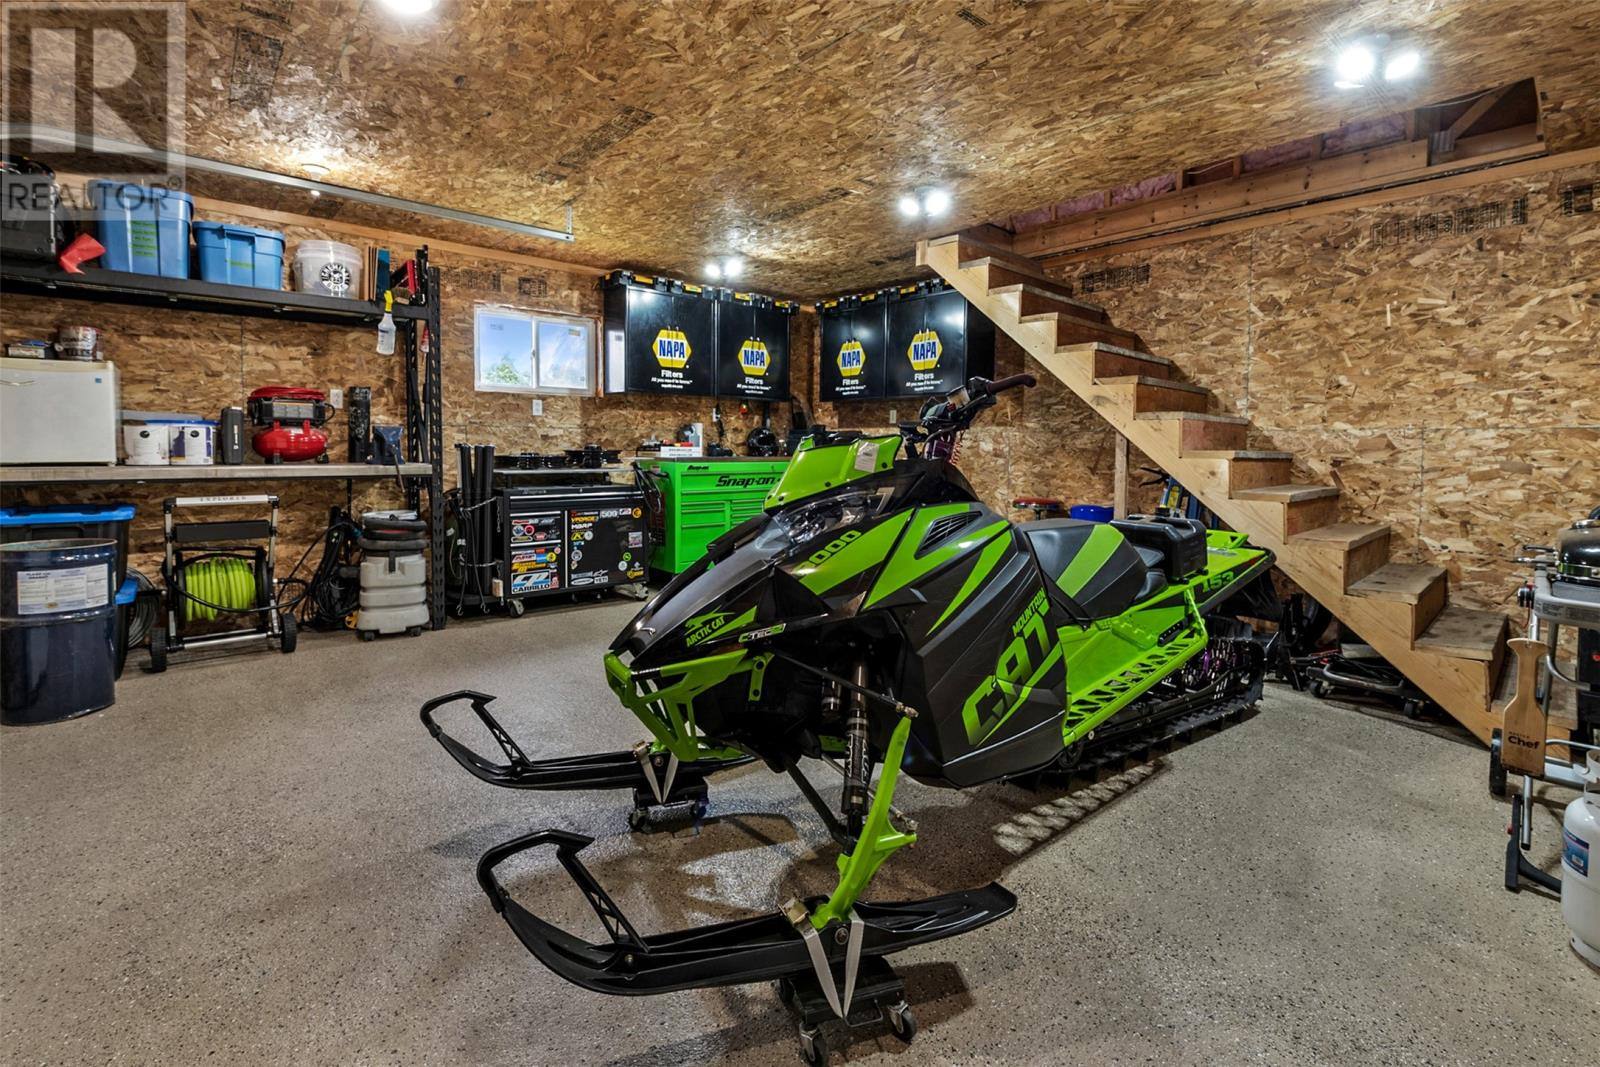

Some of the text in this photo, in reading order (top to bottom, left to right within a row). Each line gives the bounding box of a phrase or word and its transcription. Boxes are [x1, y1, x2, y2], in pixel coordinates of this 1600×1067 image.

[659, 339, 686, 359] NAPA
[913, 341, 937, 361] NAPA
[743, 349, 766, 367] NAPA
[841, 350, 861, 368] NAPA
[661, 369, 683, 378] Filters
[745, 376, 763, 385] Filters
[914, 372, 934, 380] Filters
[842, 378, 859, 386] Filters
[715, 475, 776, 488] Snap-on
[512, 583, 550, 593] CARRILLO
[686, 615, 726, 648] ARCTIC CAT
[961, 598, 1051, 746] CAT
[1508, 735, 1540, 749] Chef
